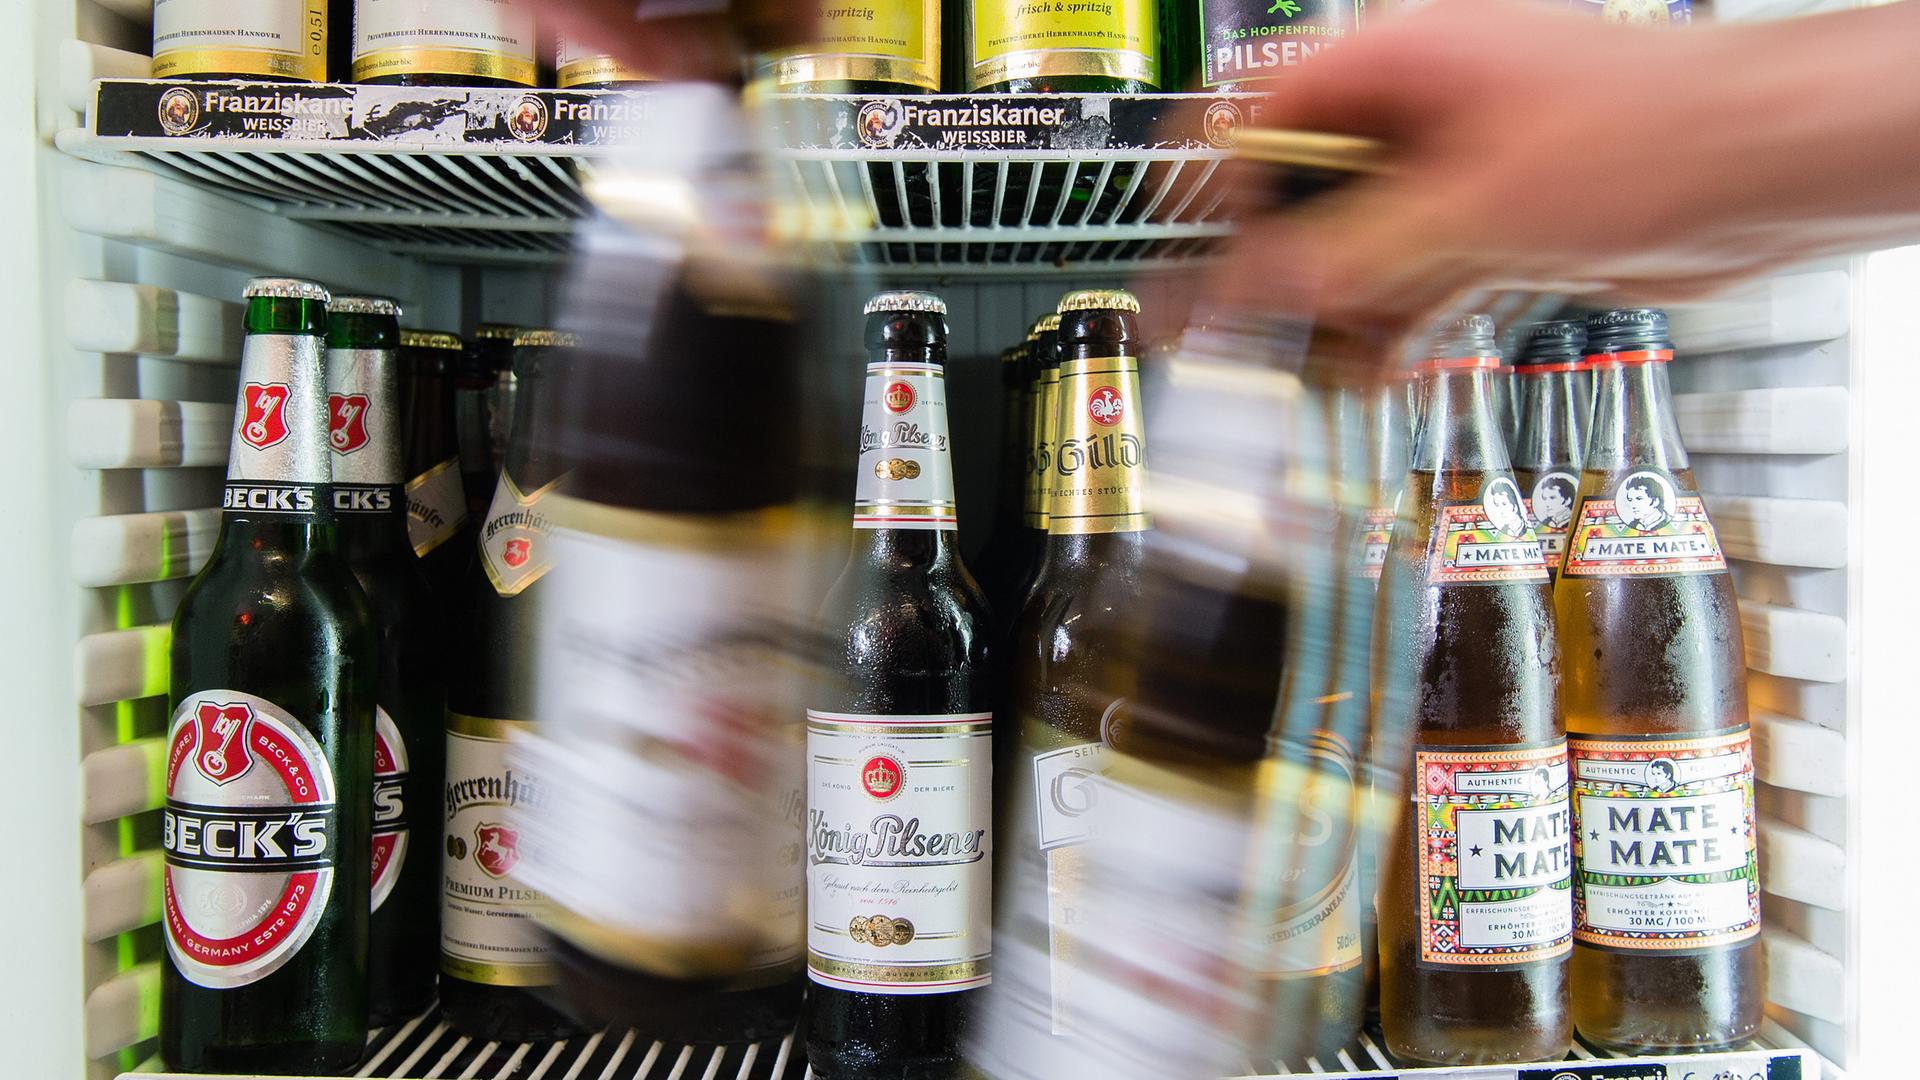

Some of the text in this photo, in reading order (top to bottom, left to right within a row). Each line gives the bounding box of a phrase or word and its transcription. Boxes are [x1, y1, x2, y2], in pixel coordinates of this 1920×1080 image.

[827, 7, 874, 20] spritzig
[1015, 1, 1112, 18] frisch & spritzig
[181, 29, 236, 37] HERRENHAUSEN
[237, 29, 281, 39] HANNOVER
[367, 29, 518, 45] PRIVATBRAUEREI HERRENHAUSEN HANNOVER
[867, 35, 907, 46] HANNOVER
[1046, 30, 1106, 38] HERRENHAUSEN
[1223, 28, 1246, 40] DAS
[904, 104, 1065, 126] Franziskaner
[243, 117, 327, 132] WEISSBIER
[942, 131, 1027, 144] WEISSBIER
[1057, 433, 1142, 477] Gild
[223, 486, 314, 510] BECK'S
[333, 487, 392, 510] CK'S
[1476, 548, 1519, 561] MATE
[1599, 540, 1698, 555] MATE MATE
[1073, 745, 1102, 759] SEIT
[1585, 766, 1636, 775] AUTHENTIC
[1467, 777, 1522, 786] AUTHENTIC
[1607, 803, 1720, 834] MATE
[1493, 809, 1569, 845] MATE
[164, 812, 327, 859] BECK'S
[808, 808, 867, 866] König
[866, 813, 985, 859] Pilsener
[1609, 837, 1721, 868] MATE
[1494, 843, 1569, 880] MATE
[445, 878, 494, 898] PREMIUM
[1267, 889, 1347, 944] MEDITERRANEAN
[1607, 907, 1655, 916] ERHÖHTER
[186, 938, 250, 957] GERMANY
[283, 885, 306, 918] 1873
[1629, 917, 1641, 926] 30
[1645, 917, 1664, 926] MG
[1666, 917, 1672, 927] /
[1675, 917, 1694, 925] 100
[1512, 931, 1524, 939] 30
[479, 943, 531, 953] HERRENHAUSEN
